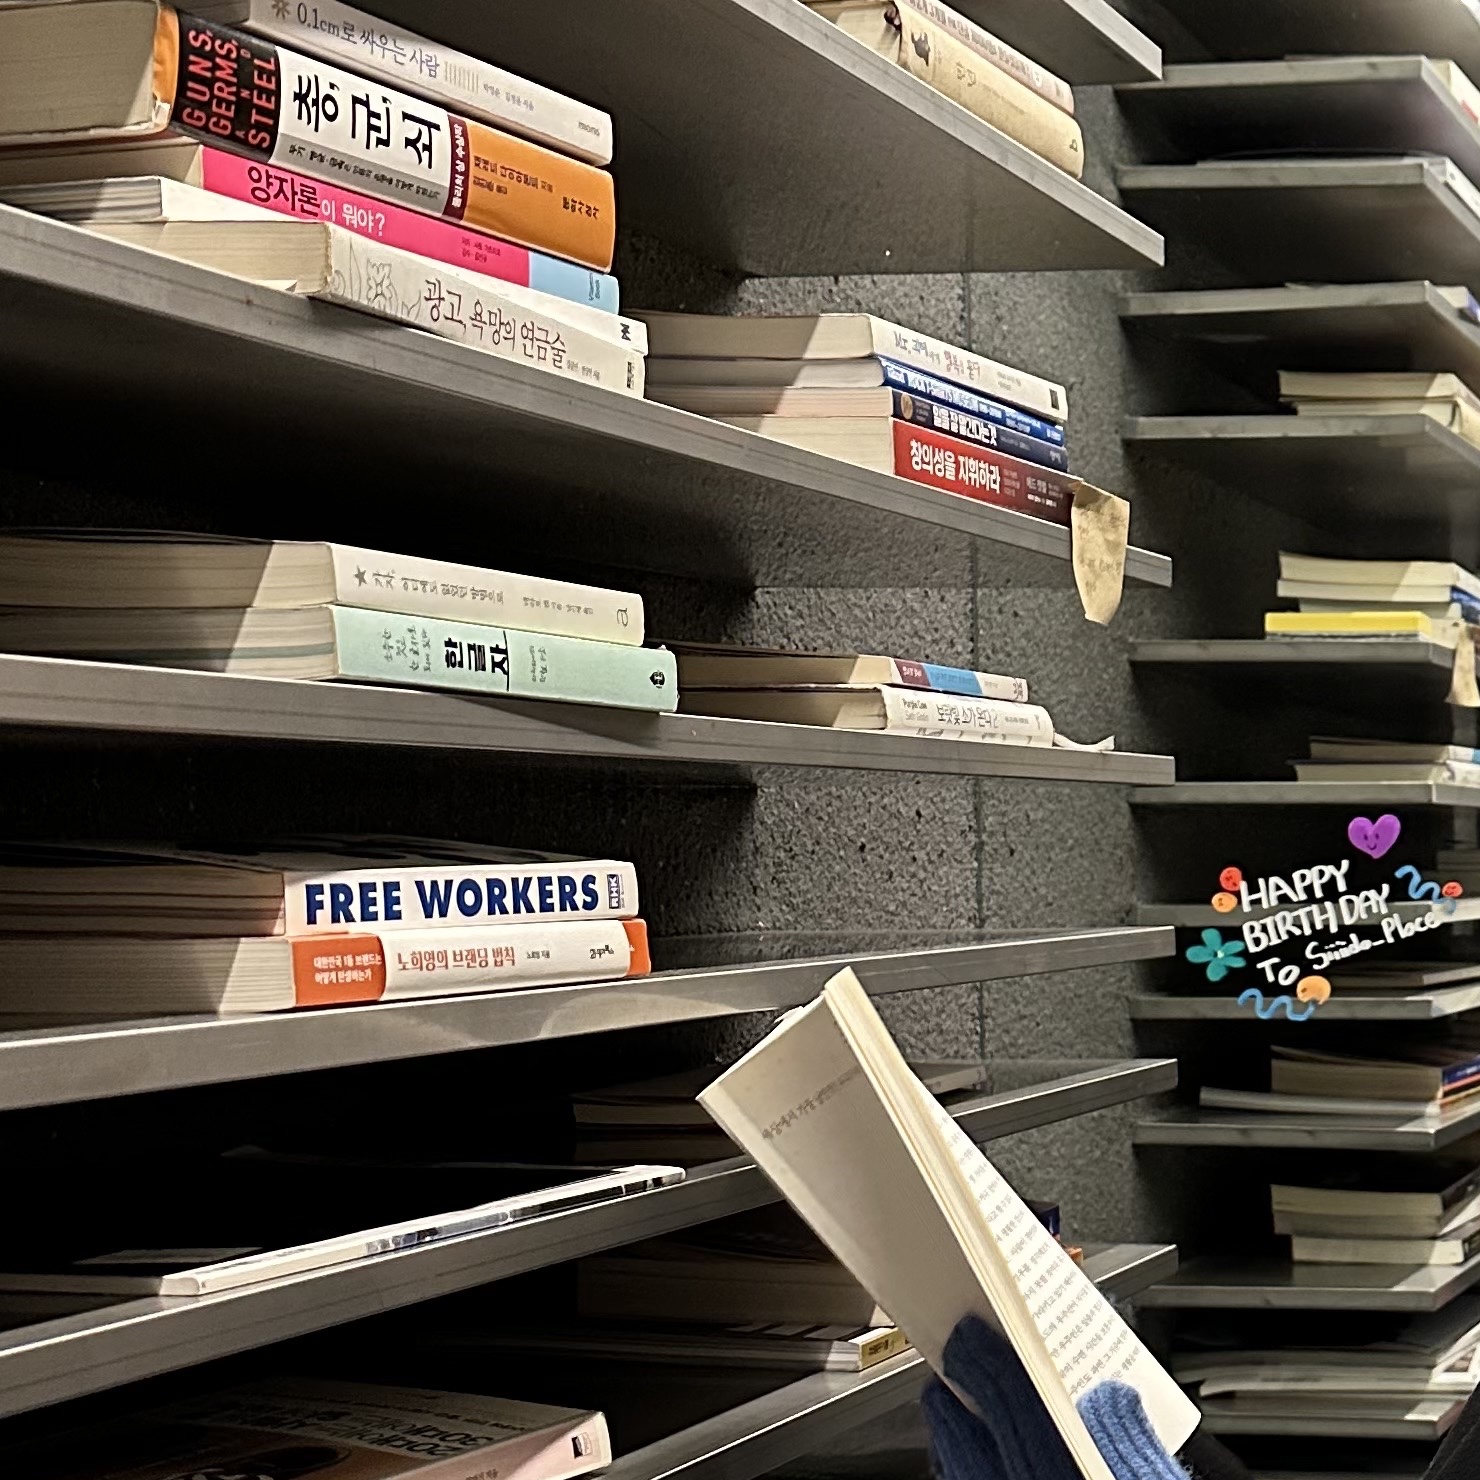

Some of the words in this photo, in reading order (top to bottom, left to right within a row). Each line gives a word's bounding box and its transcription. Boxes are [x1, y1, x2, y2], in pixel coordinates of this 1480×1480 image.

[297, 1, 357, 45] 0.1cm로
[360, 27, 406, 66] 싸우는
[409, 47, 440, 79] 사람
[247, 56, 278, 149] STEEL
[341, 202, 387, 238] 뭐야?
[469, 298, 518, 353] 욕망의
[520, 319, 567, 371] 연금술
[909, 438, 957, 482] 창의성을
[957, 455, 1001, 495] 지휘하라
[304, 880, 403, 926] FREE
[414, 873, 600, 919] WORKERS
[606, 873, 622, 910] RHK
[397, 949, 449, 972] 노희영의
[451, 947, 489, 971] 브랜딩
[491, 945, 517, 967] 법칙
